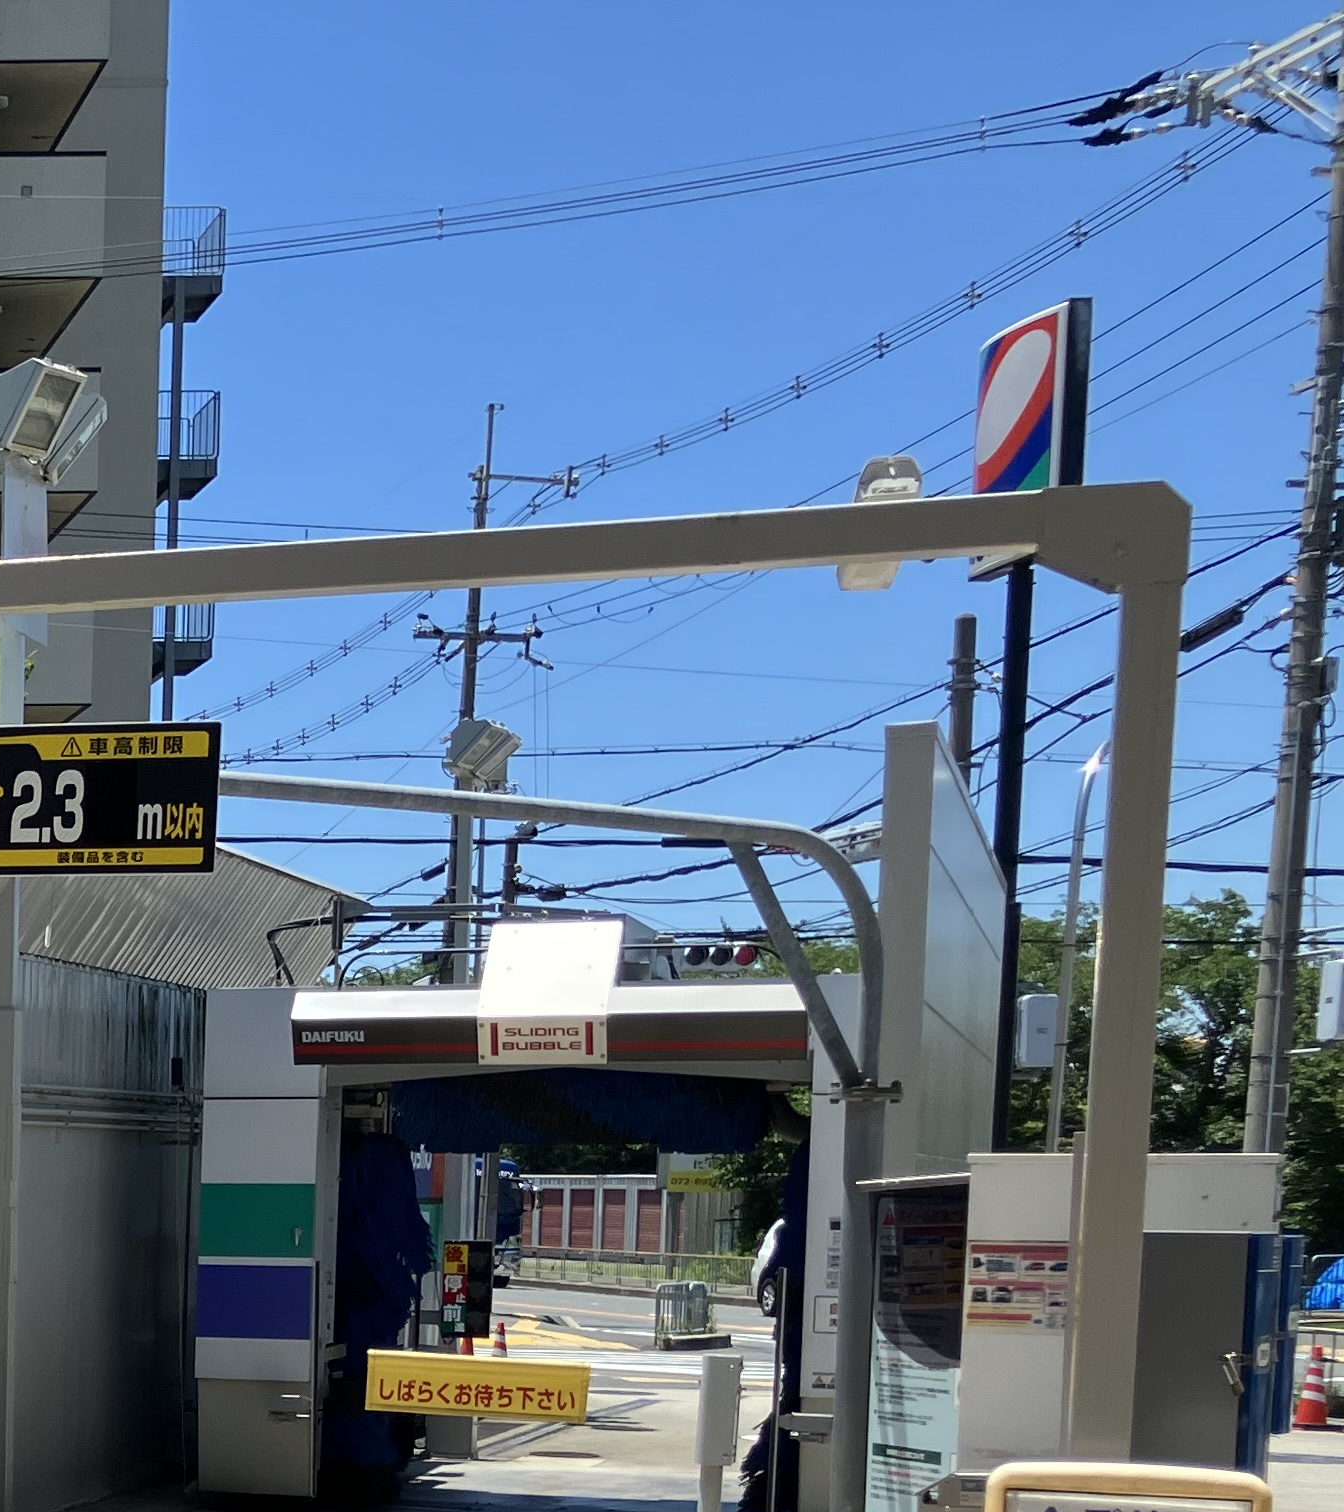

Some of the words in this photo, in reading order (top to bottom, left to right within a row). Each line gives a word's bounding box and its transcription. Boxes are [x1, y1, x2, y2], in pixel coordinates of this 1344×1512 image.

[88, 735, 183, 757] 車高制限
[10, 769, 85, 844] 2.3
[137, 803, 204, 840] m以内
[57, 851, 144, 864] 装備品を含む
[301, 1030, 365, 1043] DAIFUKU
[504, 1027, 580, 1037] SLIDING
[502, 1041, 582, 1051] BUBBLE
[379, 1378, 575, 1411] しばらくお待ち下さい
